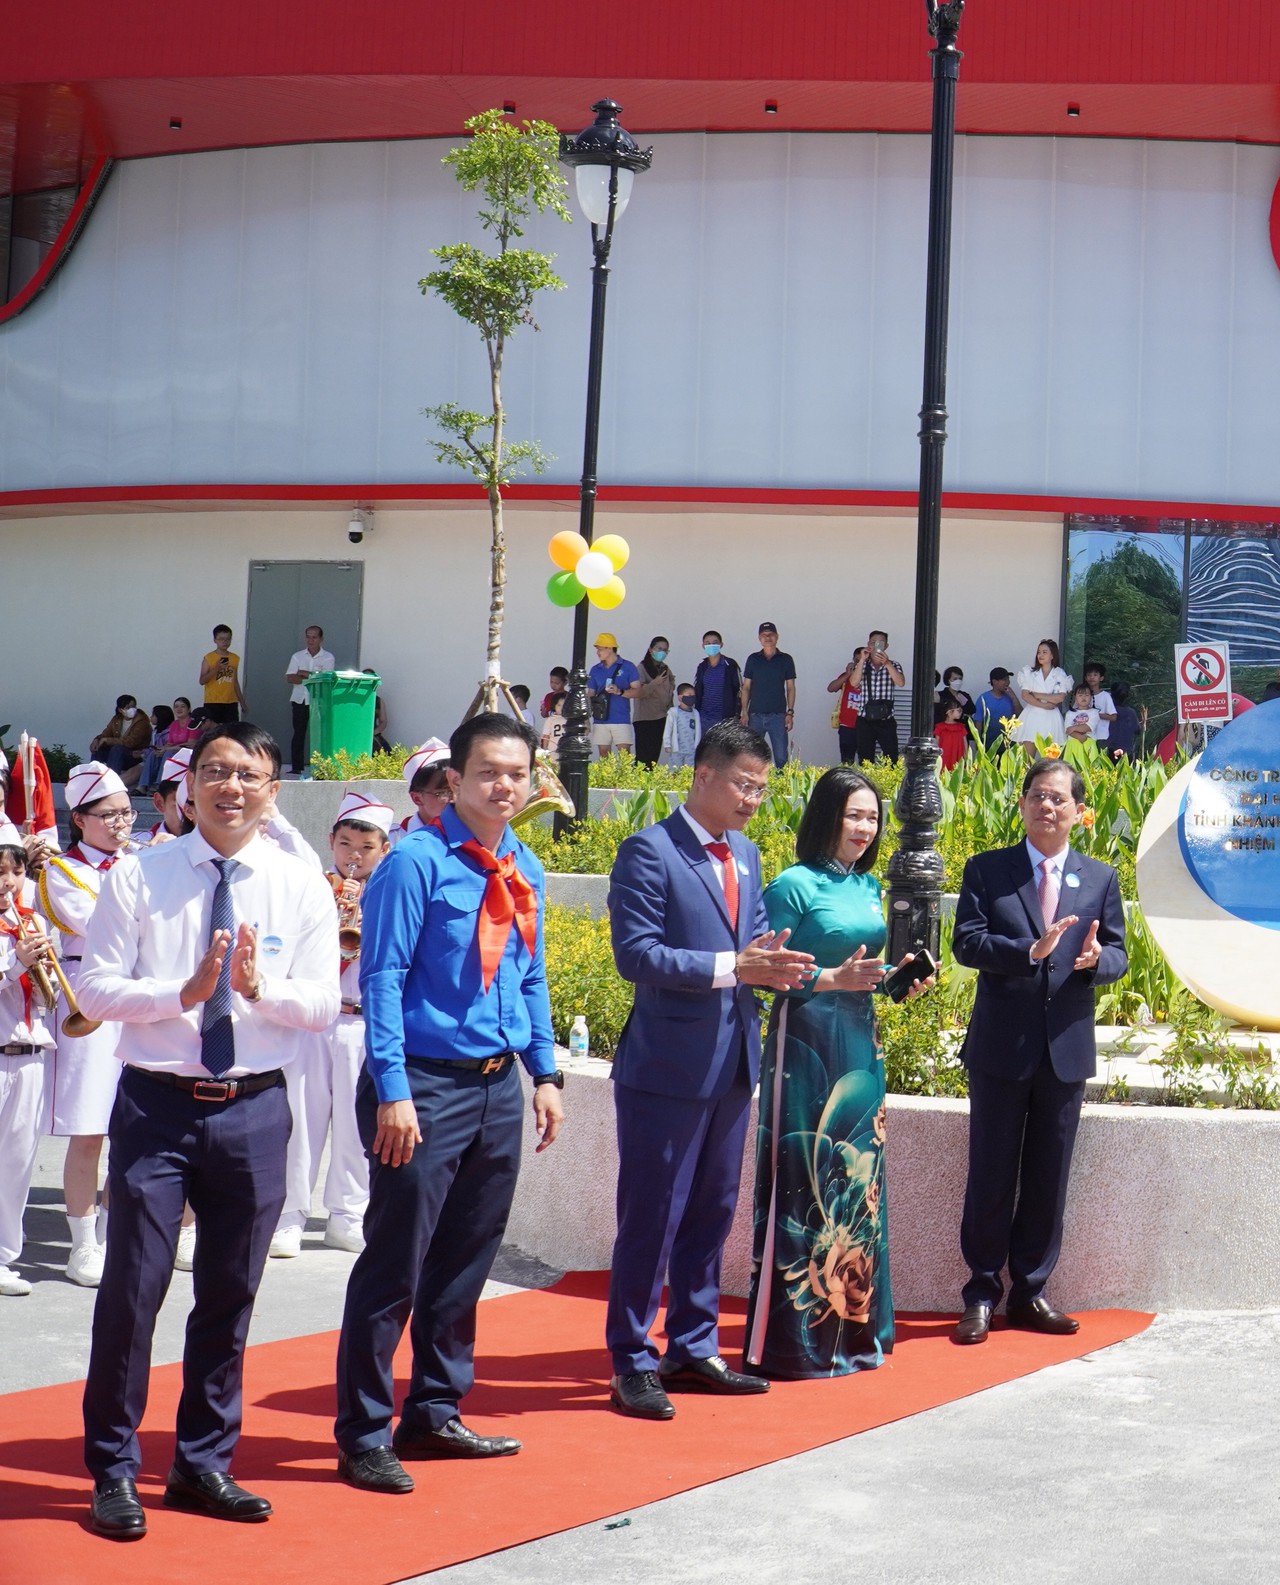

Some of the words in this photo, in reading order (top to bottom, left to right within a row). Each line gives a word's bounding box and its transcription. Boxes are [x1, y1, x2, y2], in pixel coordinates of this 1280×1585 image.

[1209, 765, 1259, 783] CÔNG
[1240, 792, 1268, 809] ĐẠI
[1193, 810, 1228, 827] TỈNH
[1224, 834, 1276, 854] NHIỆM
